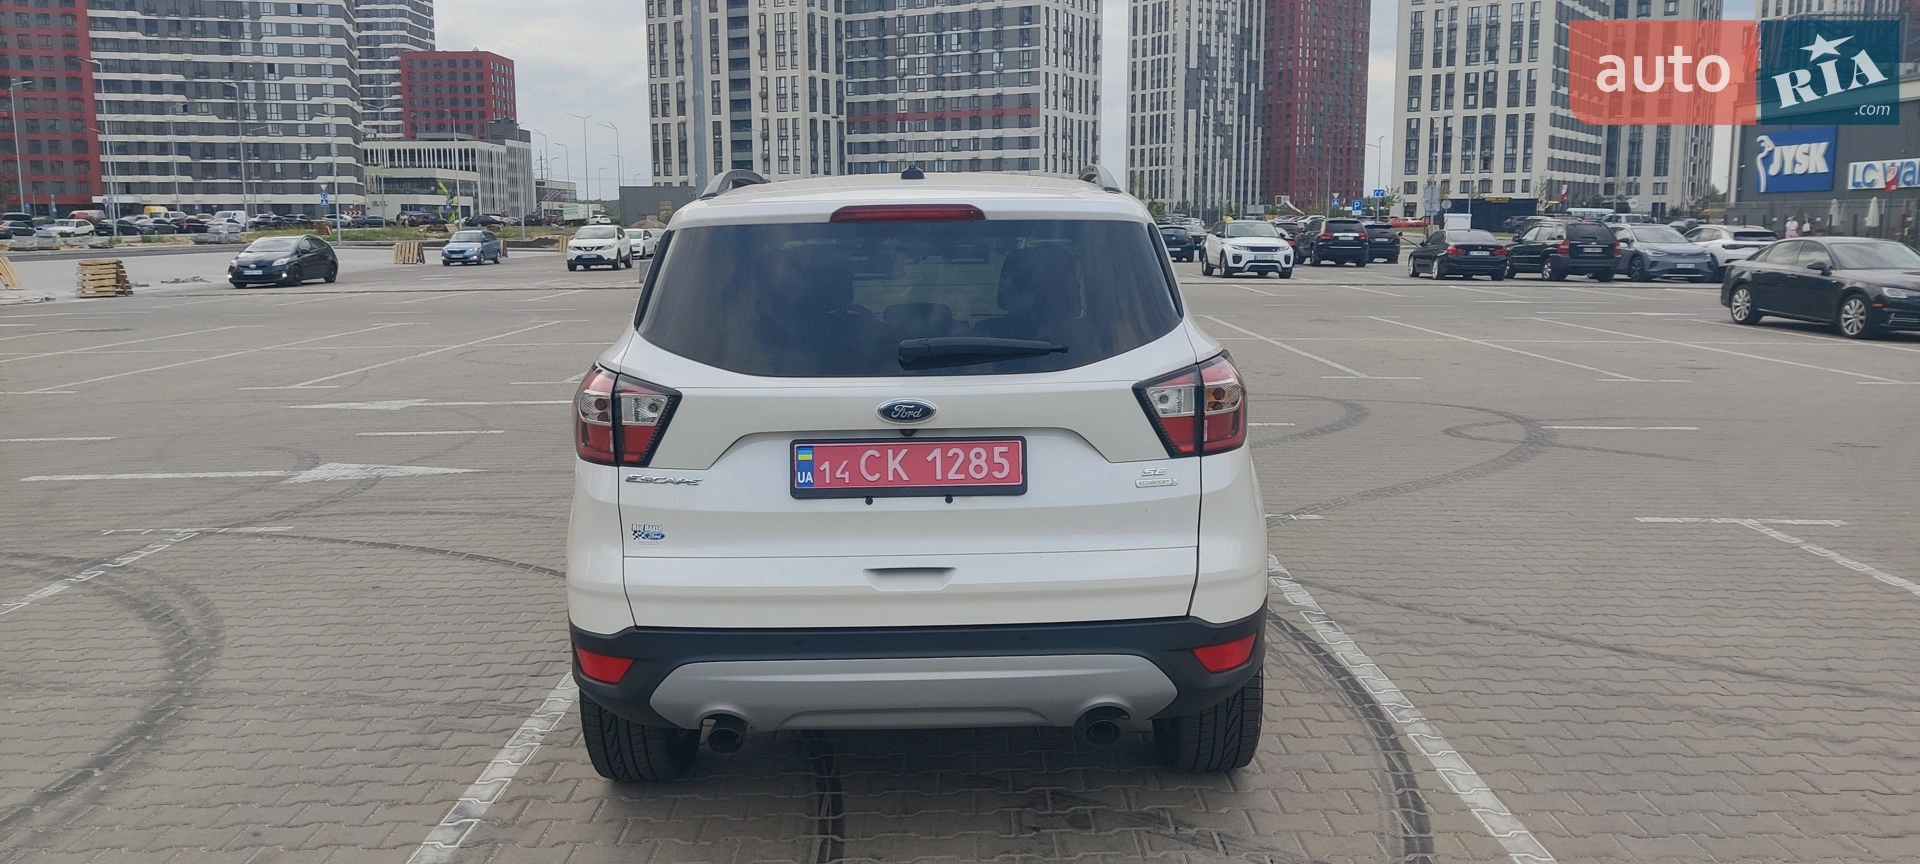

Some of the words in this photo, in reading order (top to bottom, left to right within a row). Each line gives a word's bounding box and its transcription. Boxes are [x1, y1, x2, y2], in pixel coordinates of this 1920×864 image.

[1769, 141, 1830, 175] JYSK
[1852, 163, 1877, 188] LC
[891, 404, 923, 418] Ford
[798, 471, 813, 484] UA
[819, 460, 850, 484] 14
[859, 448, 909, 483] CK
[926, 446, 1011, 480] 1285
